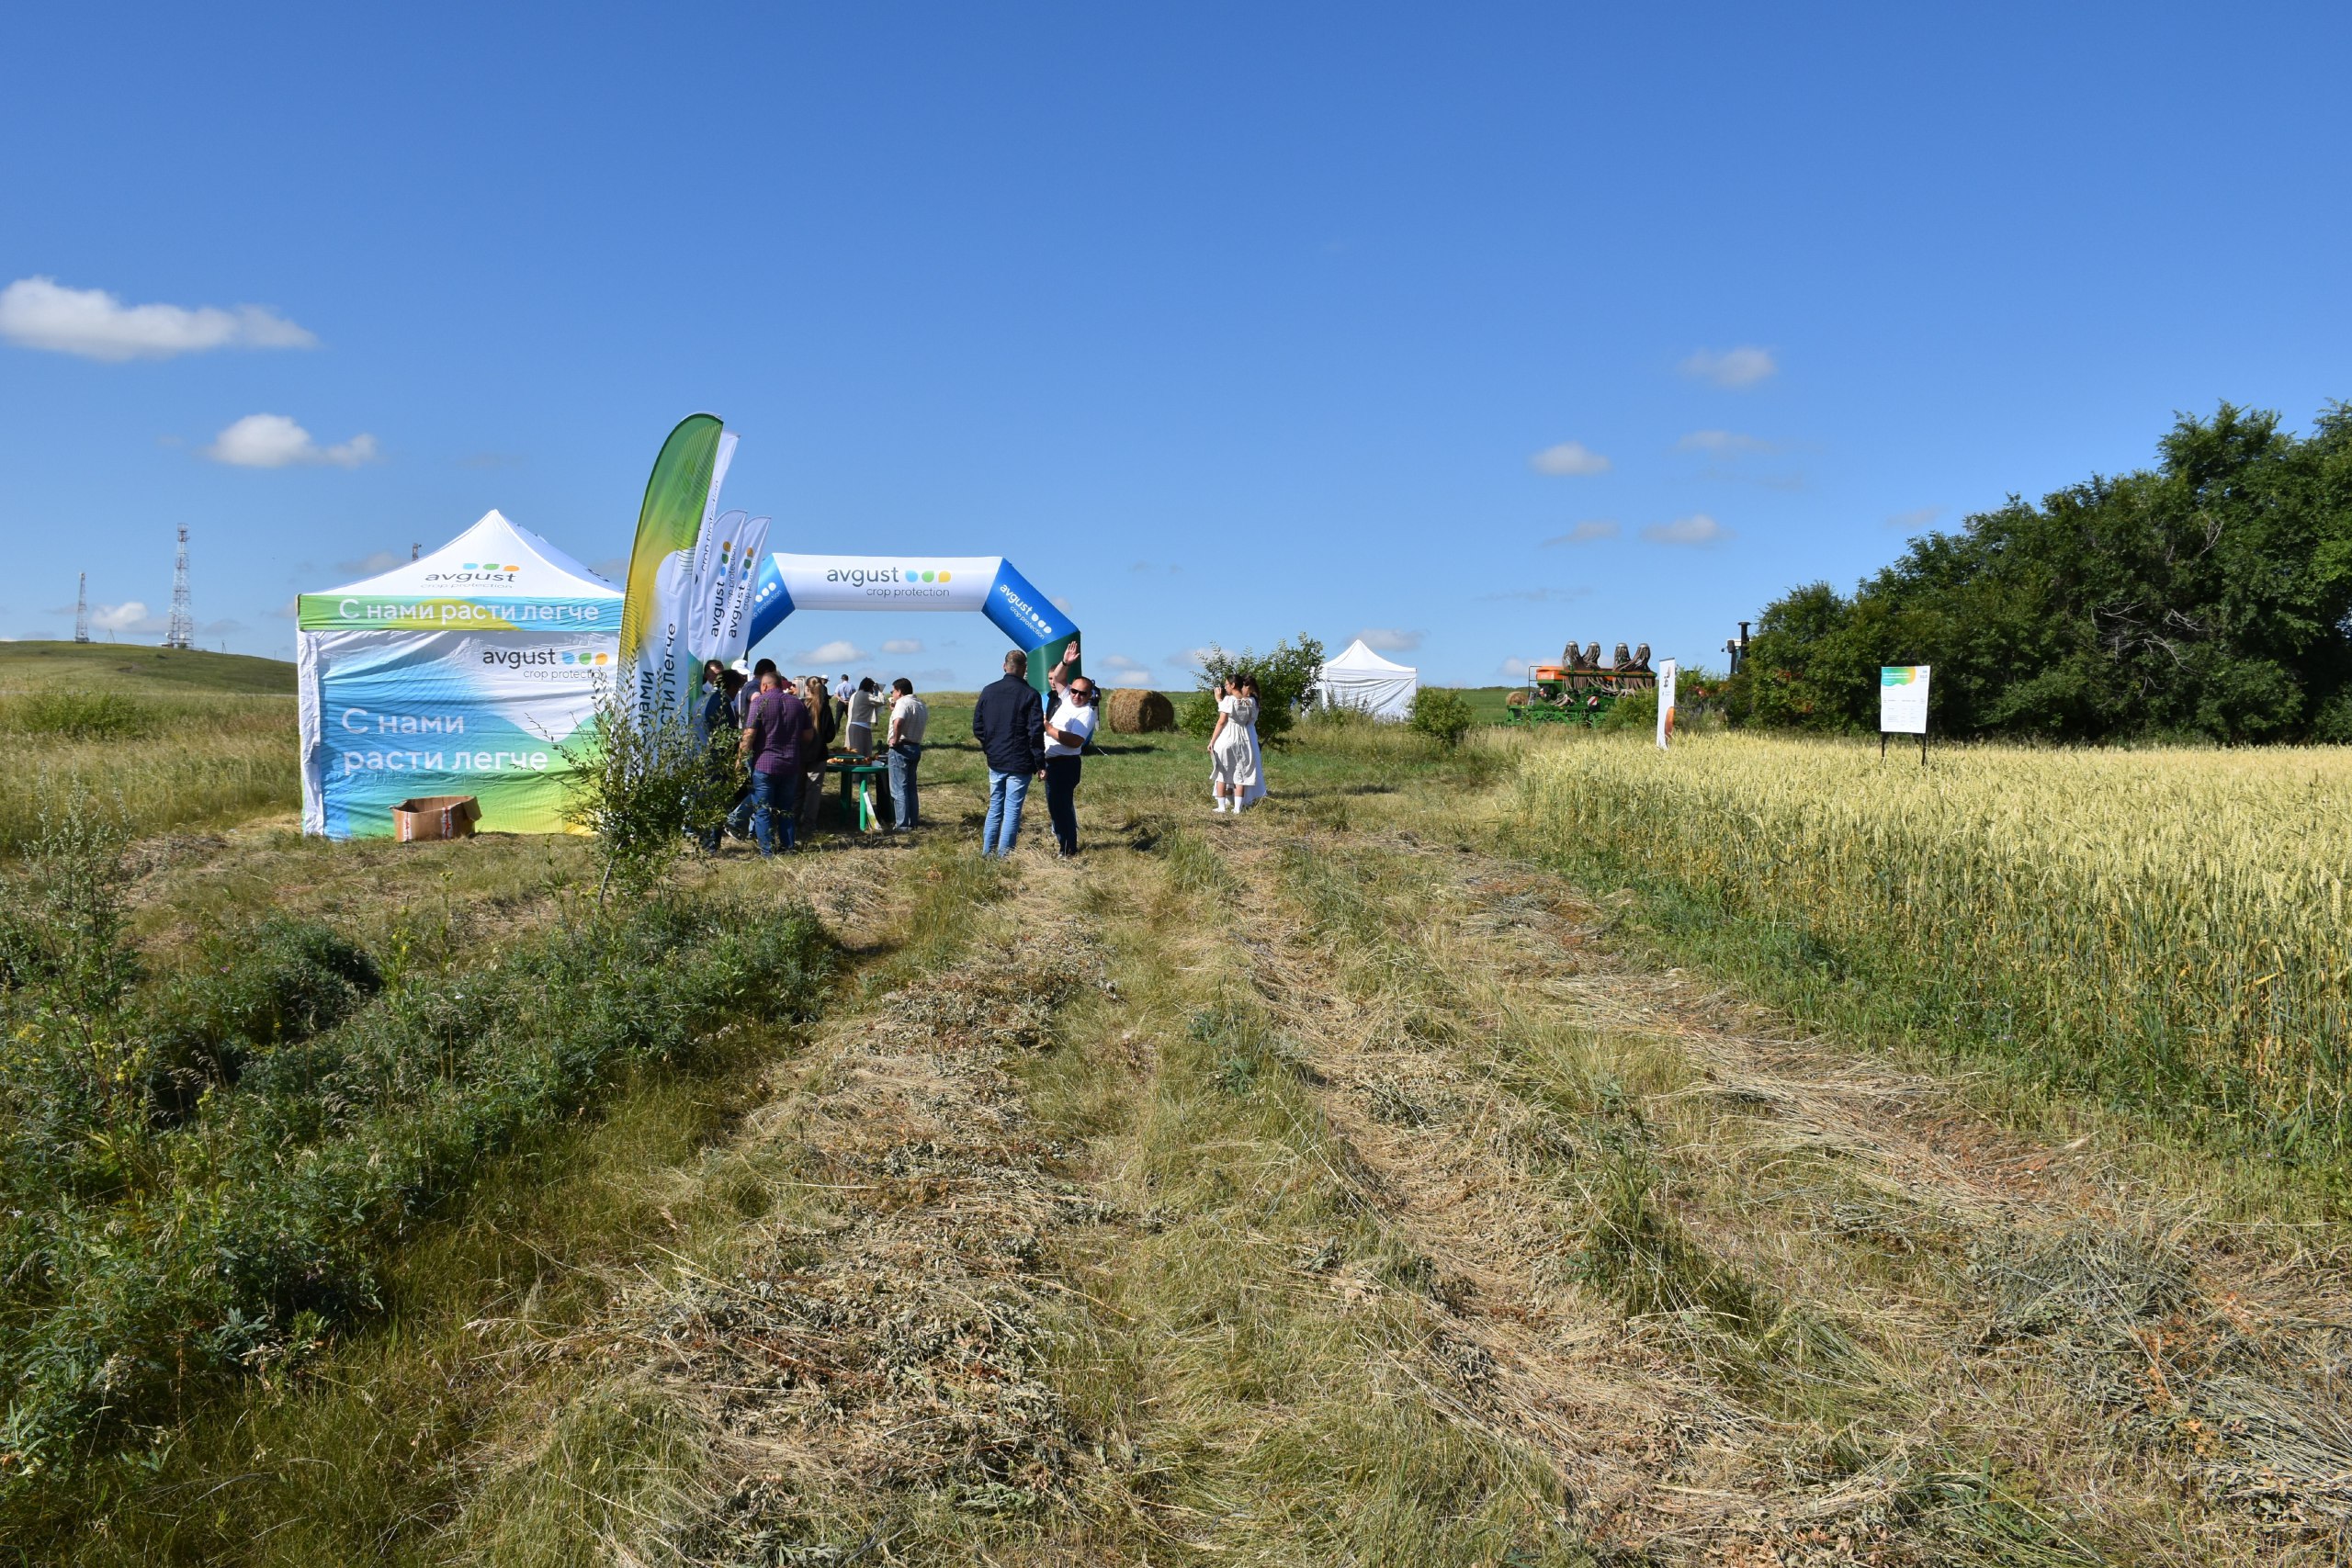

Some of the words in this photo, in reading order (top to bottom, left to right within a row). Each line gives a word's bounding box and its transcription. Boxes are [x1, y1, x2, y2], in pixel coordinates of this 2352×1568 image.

[424, 572, 516, 582] avgust
[826, 567, 899, 587] avgust
[726, 589, 734, 609] crop
[743, 592, 752, 611] crop
[866, 587, 891, 598] crop
[894, 586, 950, 598] protection
[1000, 584, 1034, 615] avgust
[339, 599, 359, 620] С
[368, 604, 435, 620] нами
[442, 602, 516, 625] расти
[522, 603, 599, 621] легче
[711, 581, 725, 637] avgust
[729, 584, 745, 638] avgust
[1010, 606, 1021, 618] crop
[1020, 616, 1045, 640] protection
[482, 649, 557, 670] avgust
[662, 623, 676, 686] легче
[524, 670, 548, 681] crop
[638, 671, 655, 727] нами
[341, 708, 368, 735] С
[379, 714, 465, 735] нами
[344, 750, 447, 775] расти
[451, 751, 548, 770] легче
